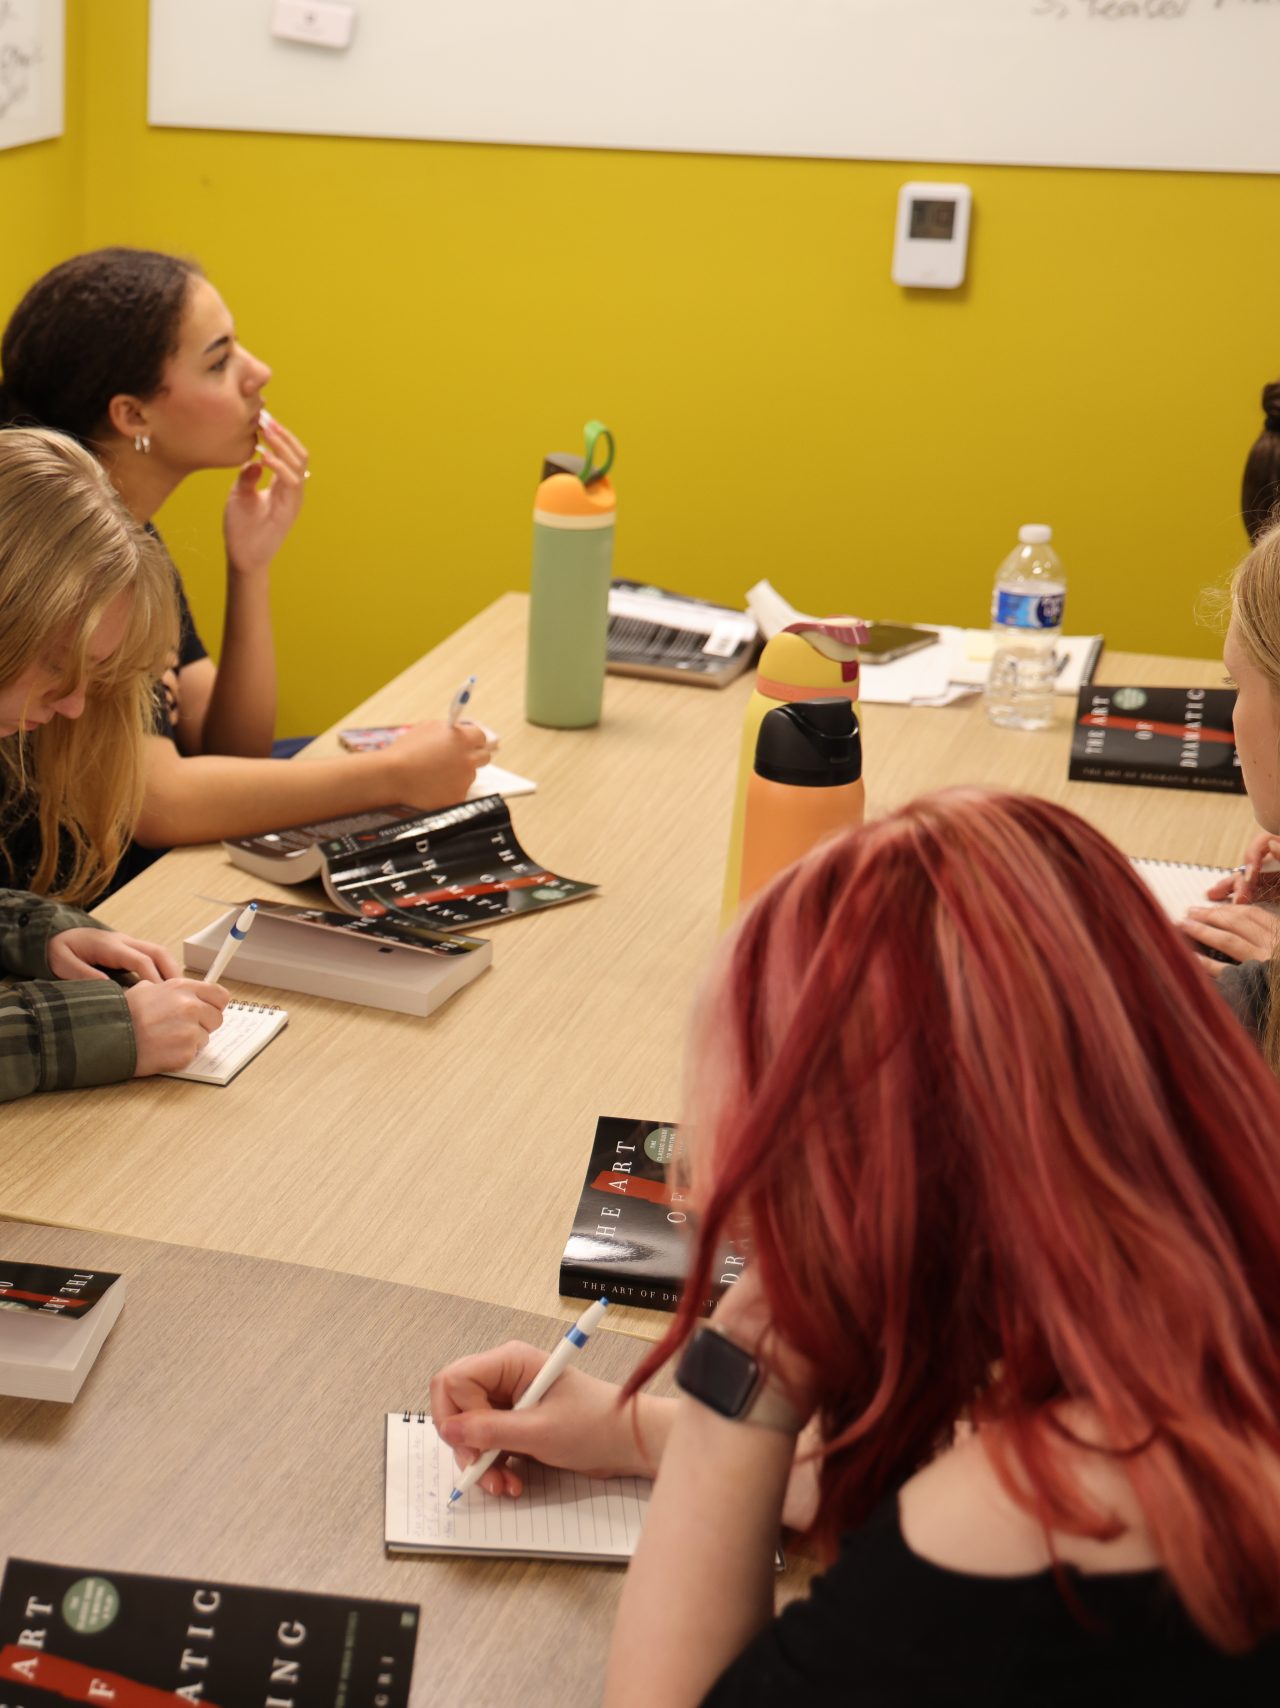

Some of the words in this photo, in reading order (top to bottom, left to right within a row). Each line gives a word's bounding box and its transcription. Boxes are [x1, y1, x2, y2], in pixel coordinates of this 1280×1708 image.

[1090, 695, 1110, 726] ART
[416, 838, 517, 915] DRAMATIC
[491, 832, 529, 874] THE
[379, 859, 470, 921] WRITING
[595, 1206, 621, 1238] HE
[608, 1141, 636, 1192] ART
[666, 1192, 687, 1224] OF
[582, 1281, 607, 1292] THE
[612, 1284, 634, 1296] ART
[640, 1288, 656, 1299] OF
[11, 1595, 53, 1681] ART
[175, 1589, 221, 1707] ATIC
[88, 1677, 116, 1699] F
